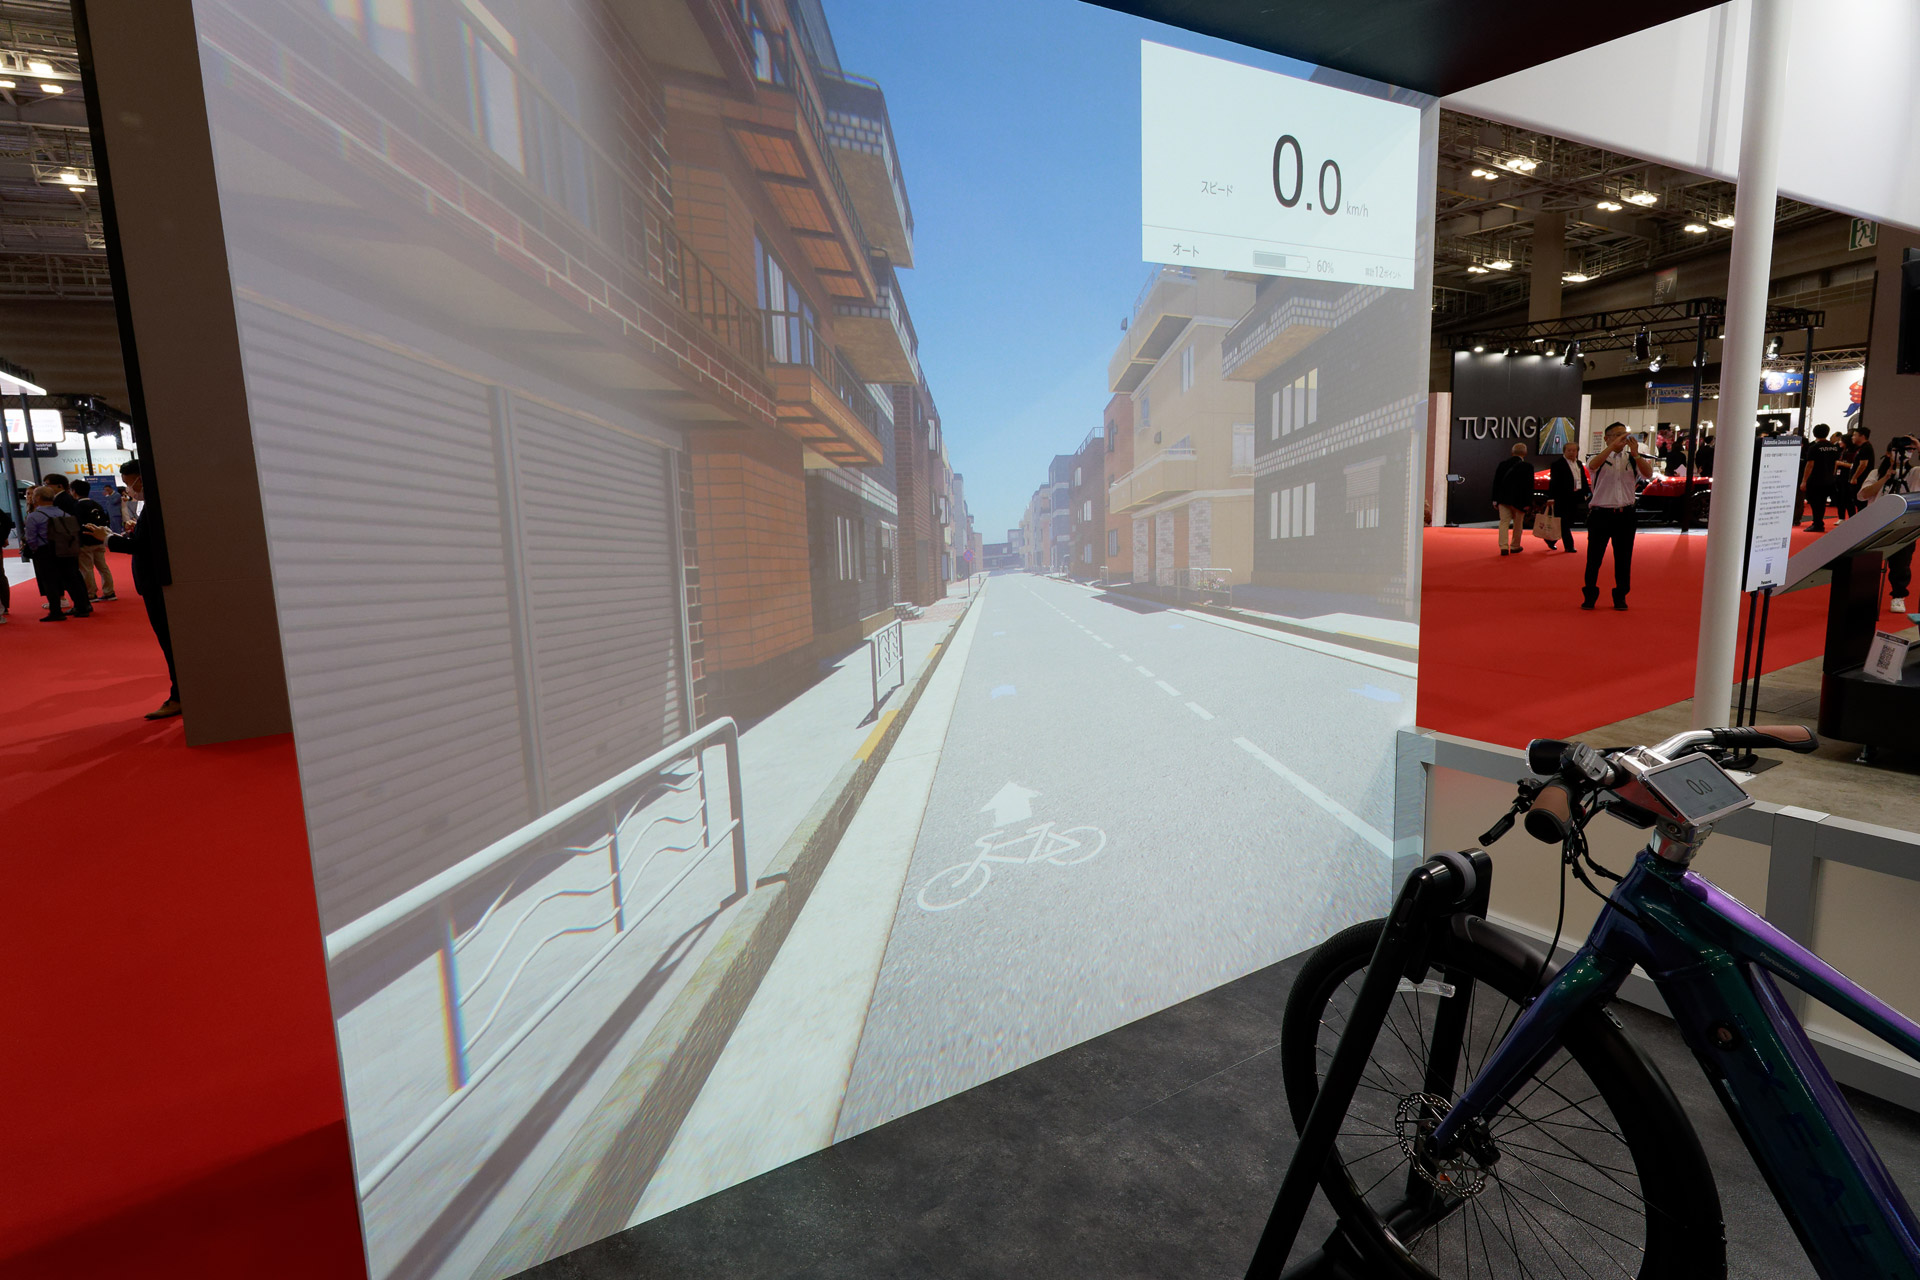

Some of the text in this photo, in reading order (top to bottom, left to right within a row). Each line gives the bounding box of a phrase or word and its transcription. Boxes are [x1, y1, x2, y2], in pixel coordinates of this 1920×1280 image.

[1272, 134, 1369, 218] 0.0 km/h
[1201, 180, 1233, 196] スピード
[1172, 243, 1200, 258] オート
[1316, 260, 1334, 274] 60%
[1459, 415, 1537, 440] TURING
[1686, 779, 1713, 796] 0.0
[1759, 951, 1800, 980] Panasonic
[1744, 1059, 1898, 1280] XEAL
